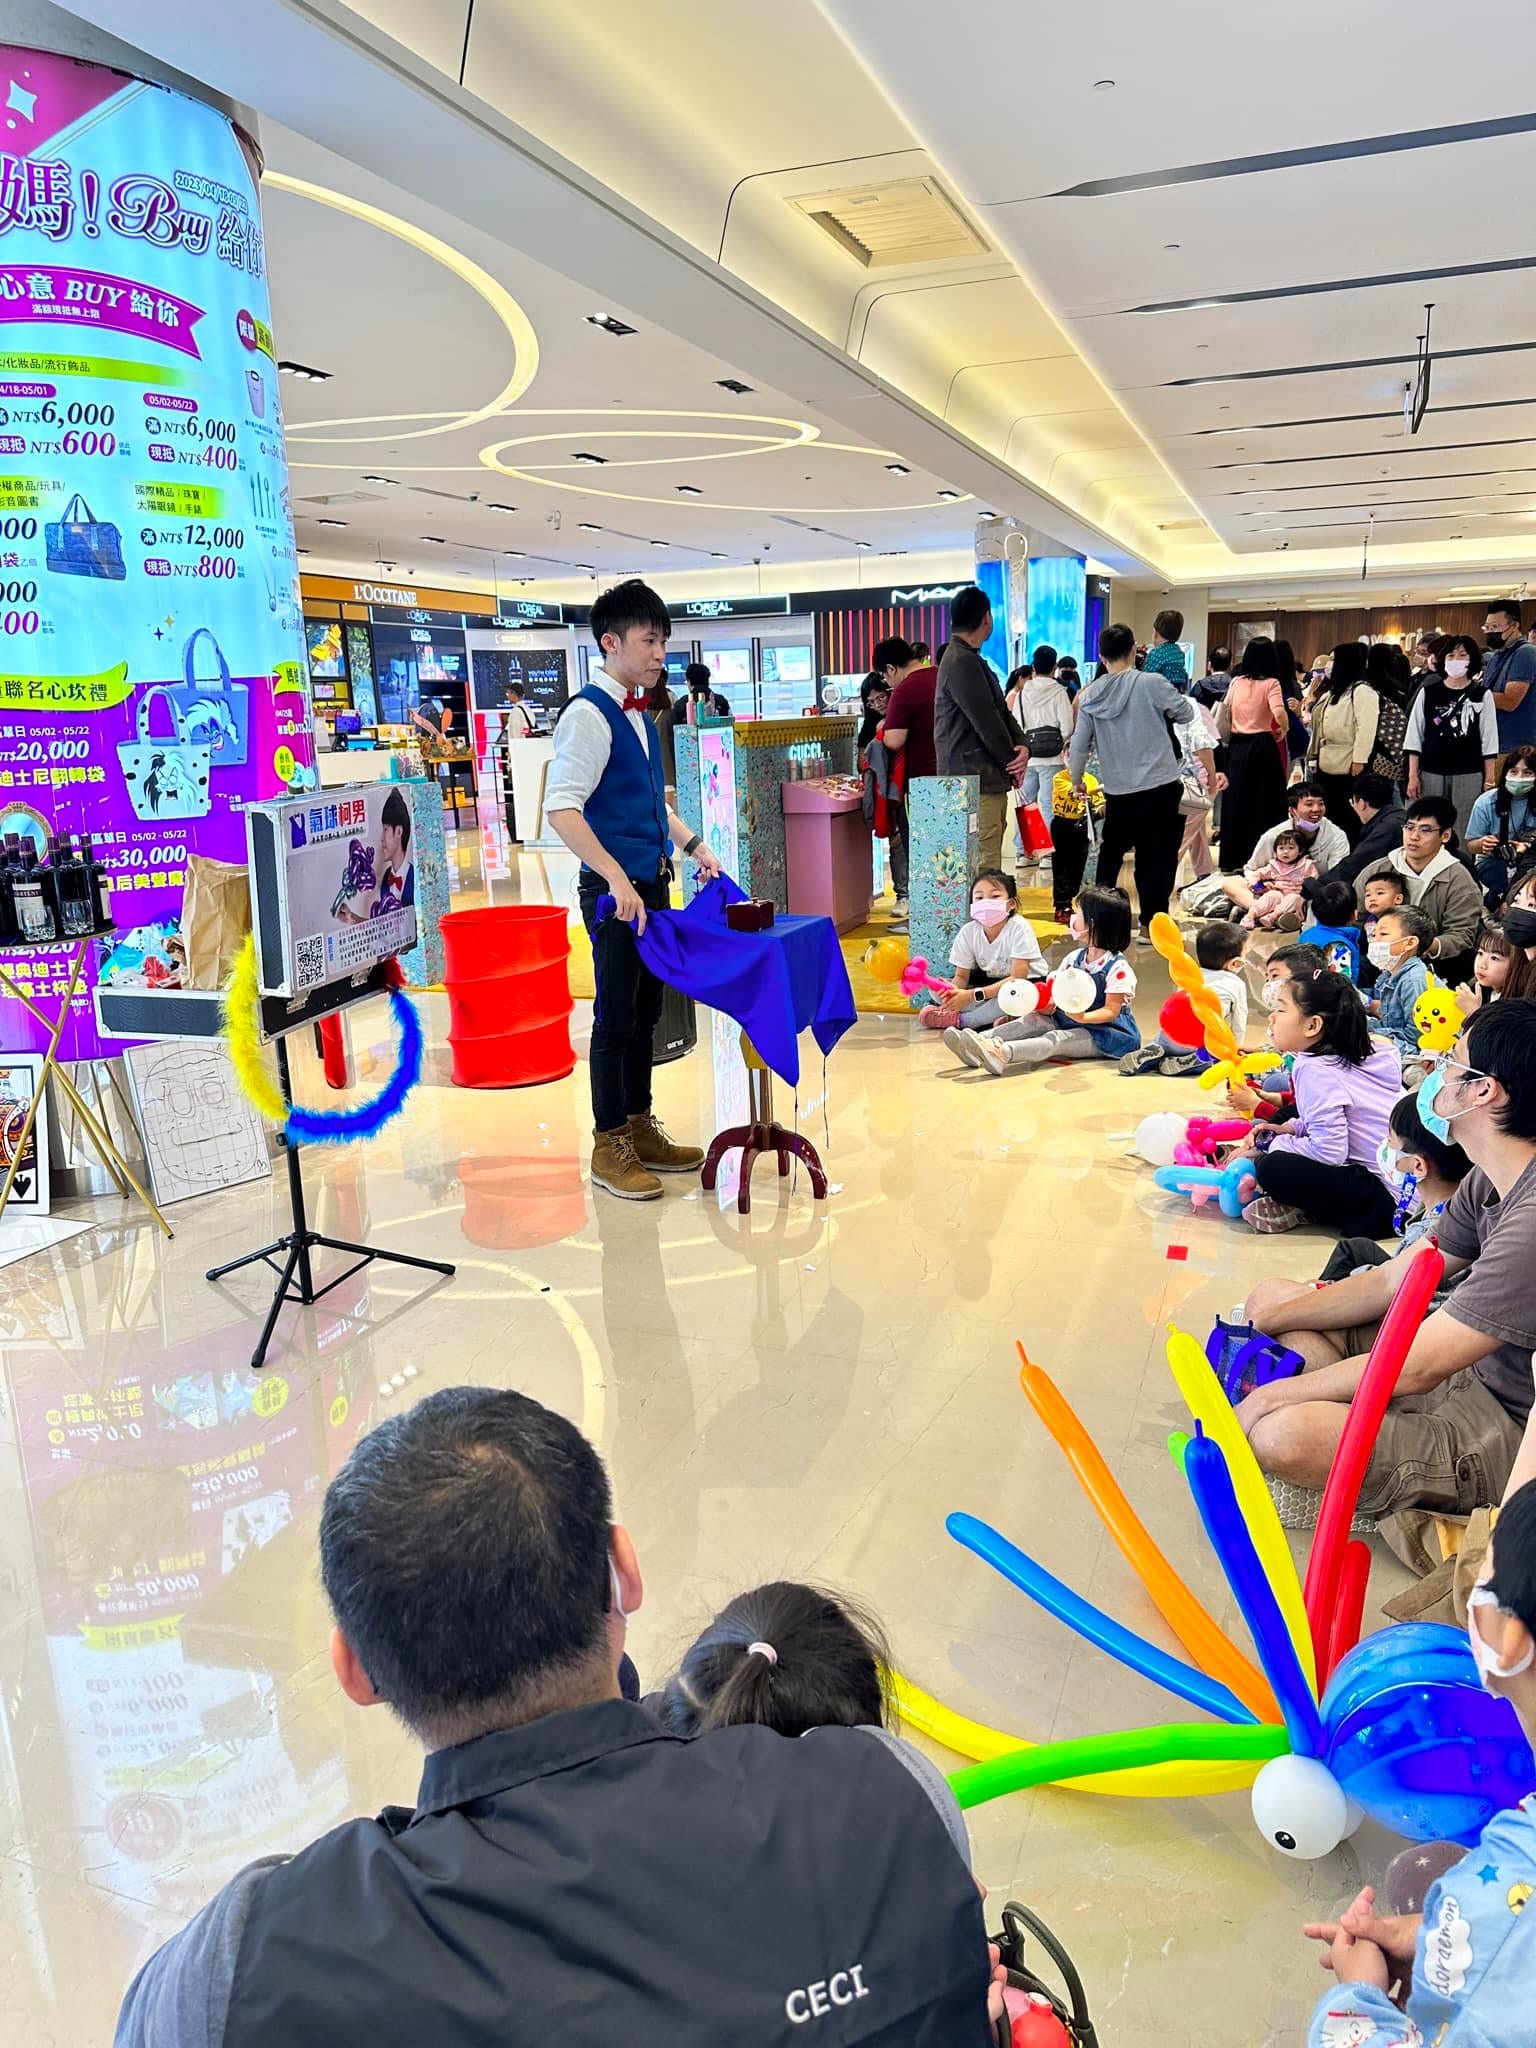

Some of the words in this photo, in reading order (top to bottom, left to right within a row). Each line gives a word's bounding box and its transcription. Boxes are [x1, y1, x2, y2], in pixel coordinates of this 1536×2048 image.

[107, 174, 212, 254] Buy
[64, 279, 126, 307] BUY
[130, 288, 179, 327] 給你
[12, 401, 115, 428] NT$6,000
[149, 396, 193, 410] 05/02-05/22
[164, 416, 236, 443] NT$6,000
[31, 430, 116, 457] NT$600
[150, 446, 174, 461] 現抵
[179, 445, 237, 471] NT$400
[0, 517, 38, 540] 00
[160, 525, 244, 551] NT$12,000
[145, 559, 171, 576] 現抵
[174, 555, 236, 579] NT$800
[353, 583, 418, 605] L'OCCITANE
[0, 611, 39, 635] 00
[0, 680, 108, 702] 聯名心坎禮
[30, 727, 57, 737] 05/02
[63, 726, 90, 736] 05/22
[789, 742, 822, 760] GUCCI
[309, 799, 366, 834] 氣球柯男
[132, 832, 157, 841] 05/02
[163, 829, 187, 839] 05/22
[1431, 1902, 1457, 1996] doraemon
[785, 1964, 869, 2023] CECI
